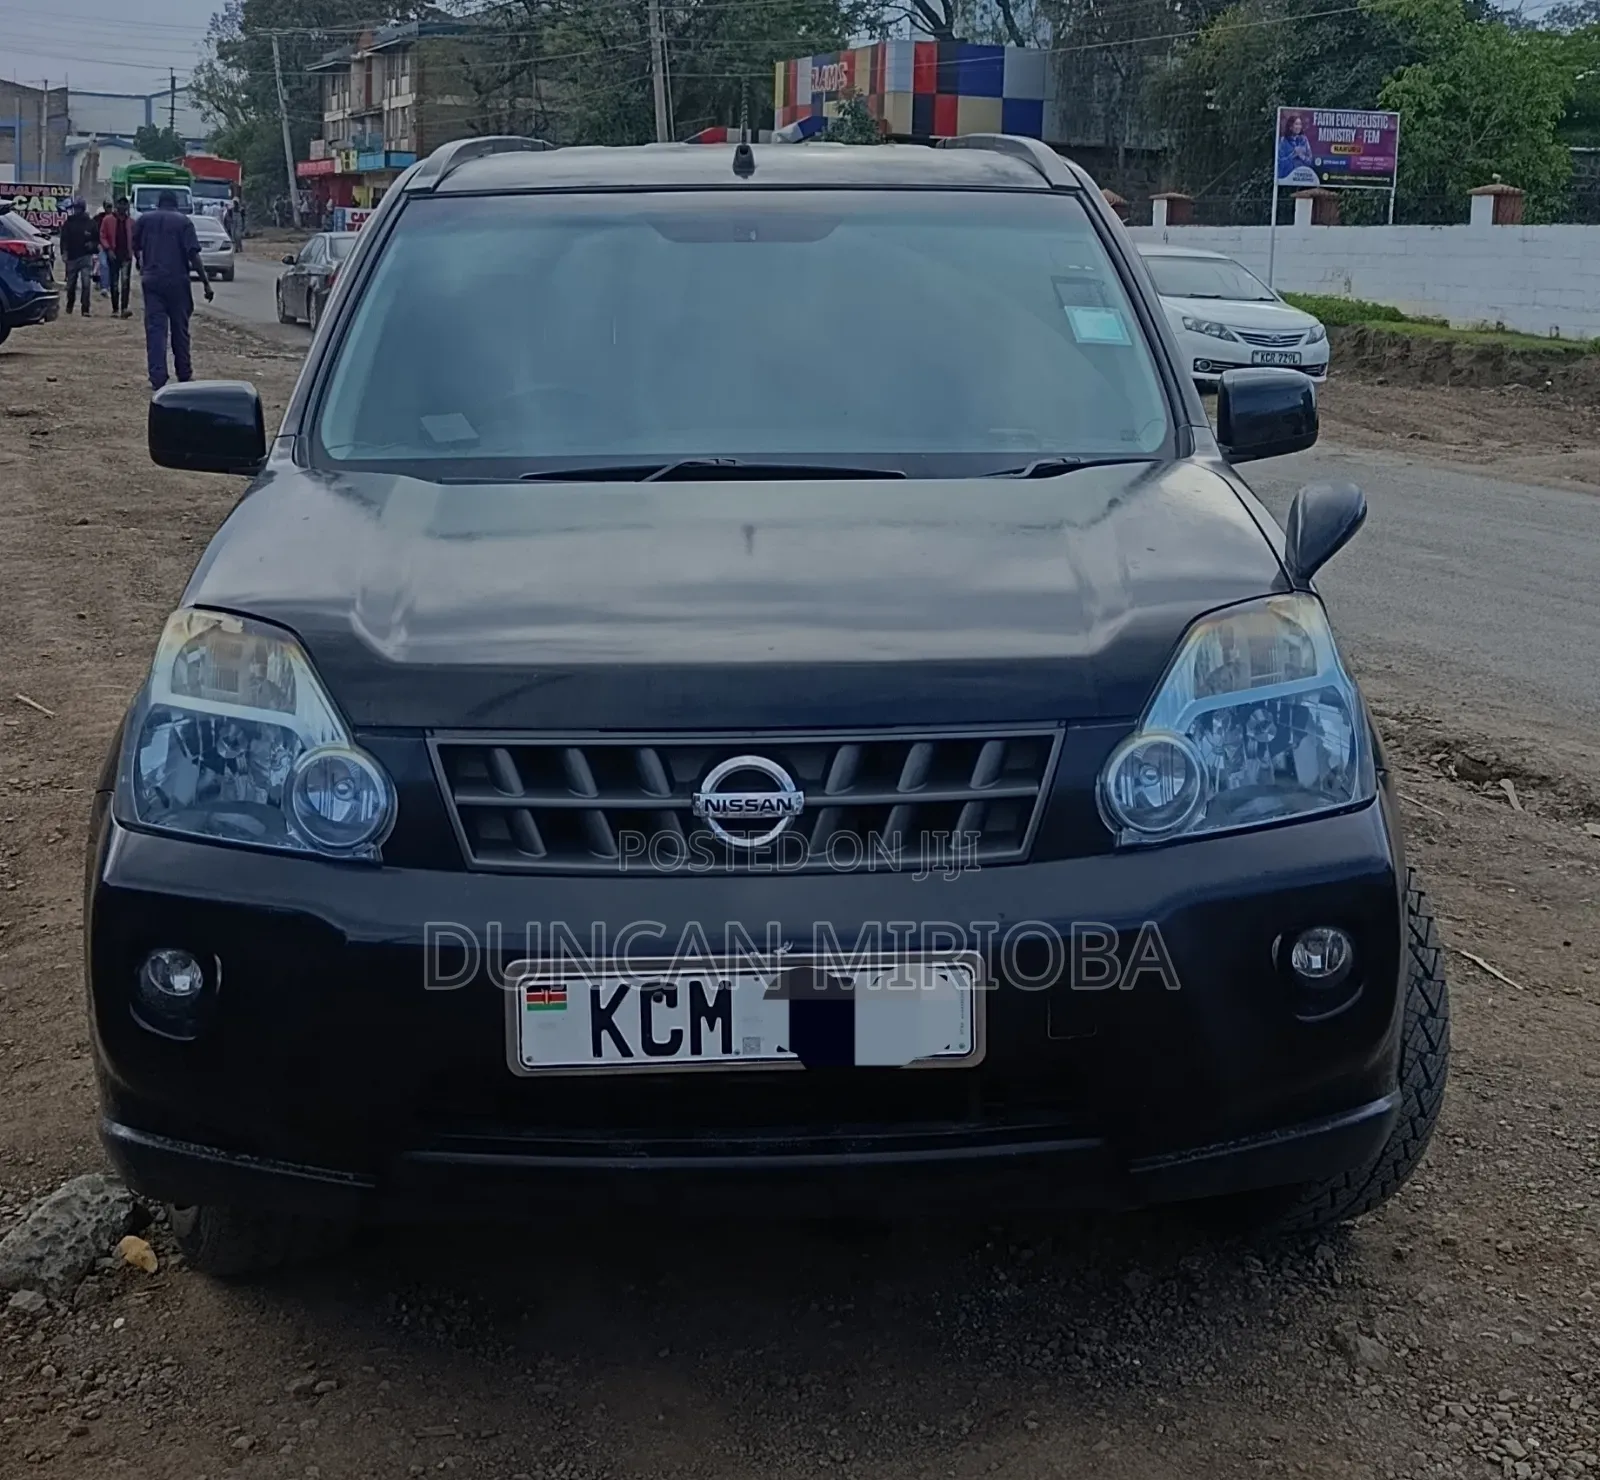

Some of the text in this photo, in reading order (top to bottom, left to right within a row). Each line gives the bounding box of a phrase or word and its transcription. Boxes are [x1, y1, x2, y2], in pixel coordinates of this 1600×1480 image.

[1313, 112, 1389, 129] FAITH EVANGELISTIC
[1318, 127, 1357, 142] MINISTRY
[1363, 129, 1380, 144] FEM
[51, 187, 70, 196] 032
[13, 195, 57, 212] CAR
[703, 796, 793, 813] NISSAN
[590, 979, 733, 1058] KCM
